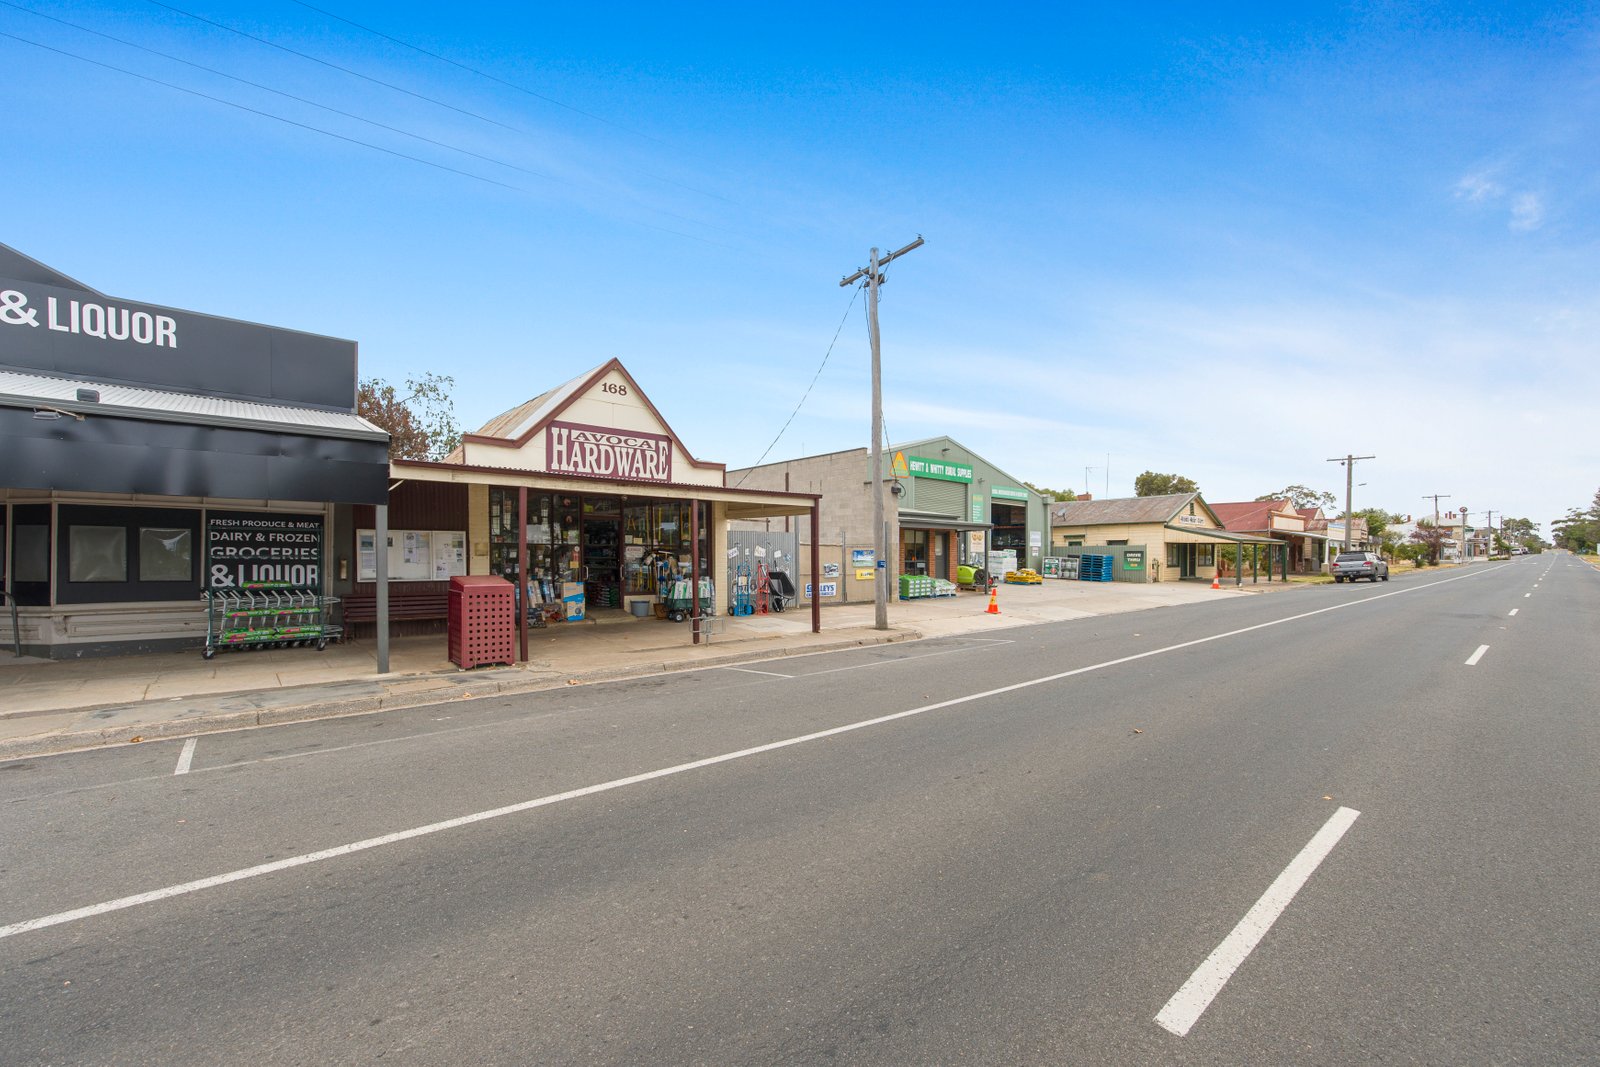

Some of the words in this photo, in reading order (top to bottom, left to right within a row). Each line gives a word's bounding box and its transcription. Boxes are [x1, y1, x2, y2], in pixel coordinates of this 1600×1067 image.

[0, 290, 40, 328] &
[48, 297, 177, 348] LIQUOR
[602, 382, 627, 396] 168
[573, 432, 654, 449] AVOCA
[551, 427, 669, 480] HARDWARE
[945, 465, 957, 477] RURAL
[957, 467, 972, 479] SUPPLIES
[242, 520, 286, 528] PRODUCE
[210, 532, 252, 541] DAIRY
[255, 533, 265, 541] &
[269, 533, 320, 543] FROZEN
[210, 546, 318, 560] GROCERIES
[211, 564, 235, 587] &
